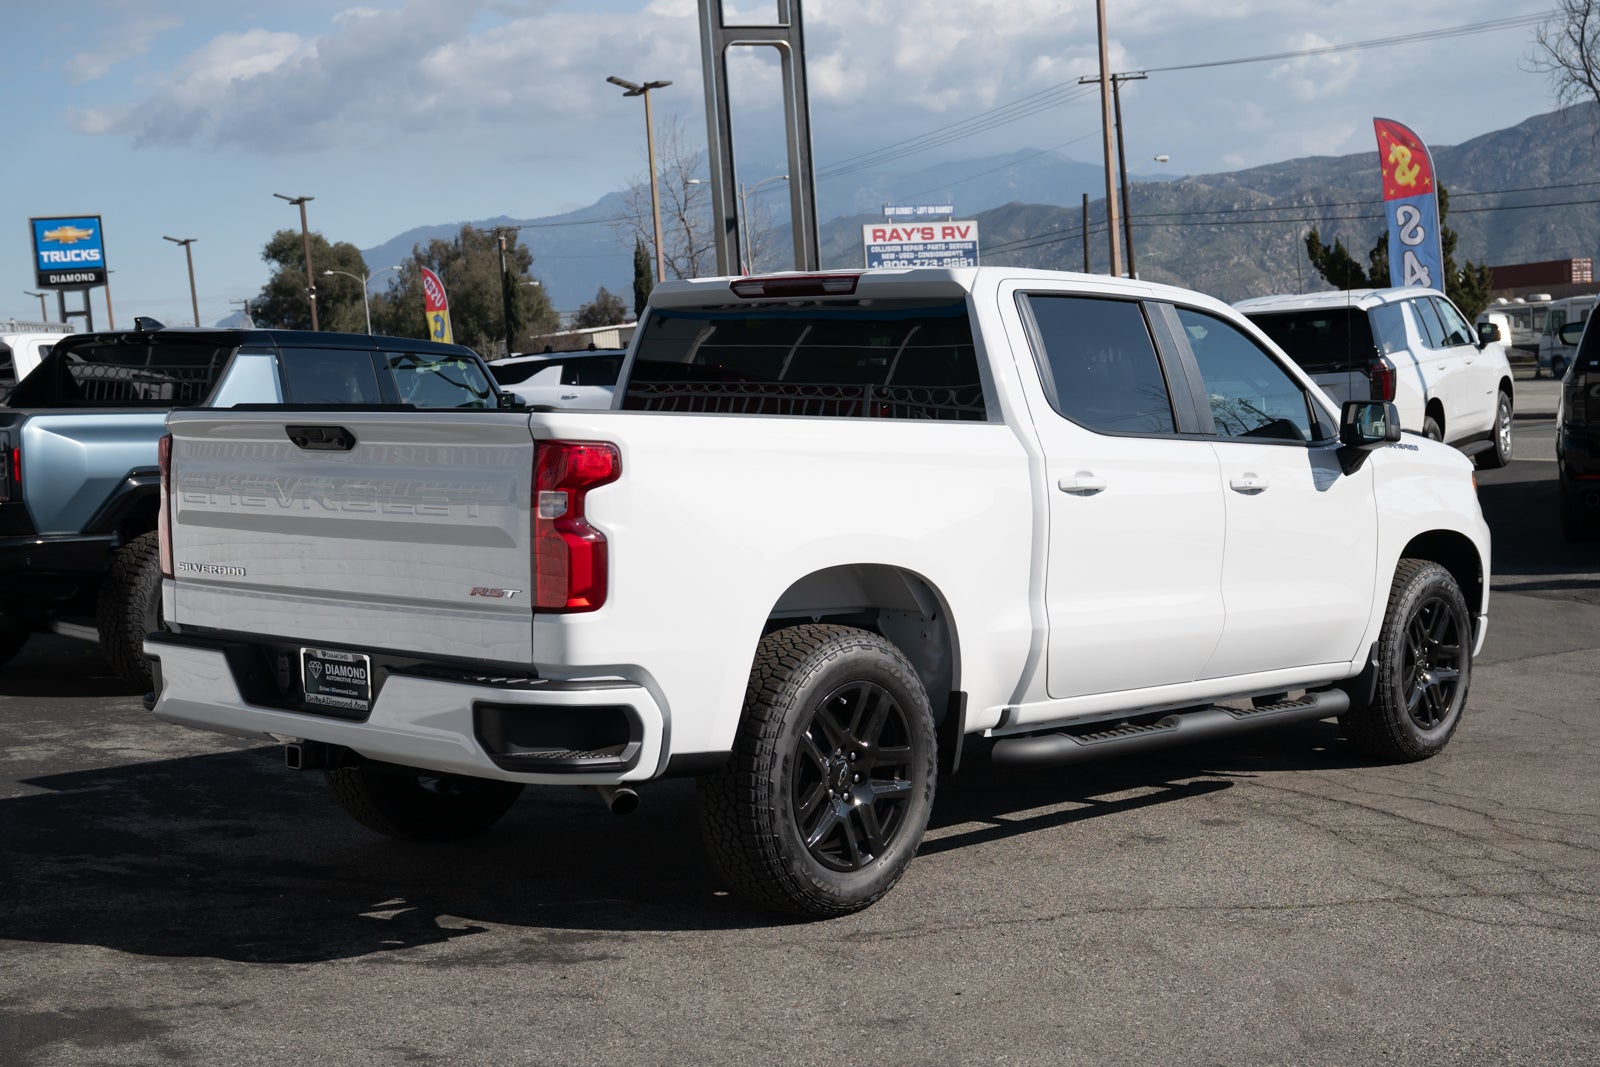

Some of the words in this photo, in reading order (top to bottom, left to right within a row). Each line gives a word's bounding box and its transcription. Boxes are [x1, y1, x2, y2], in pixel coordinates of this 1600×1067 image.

[872, 226, 935, 242] RAY'S
[941, 225, 971, 240] RV
[870, 245, 902, 253] COLLISION
[902, 244, 924, 252] REPAIR
[927, 243, 946, 251] PARTS
[948, 242, 973, 250] SERVICE
[40, 248, 101, 263] TRUCKS
[49, 272, 96, 284] DIAMOND
[182, 475, 494, 519] CHEVROLET
[177, 561, 246, 577] SILVERADO
[470, 586, 522, 598] RST
[325, 664, 366, 679] DIAMOND
[352, 678, 366, 686] GROUP
